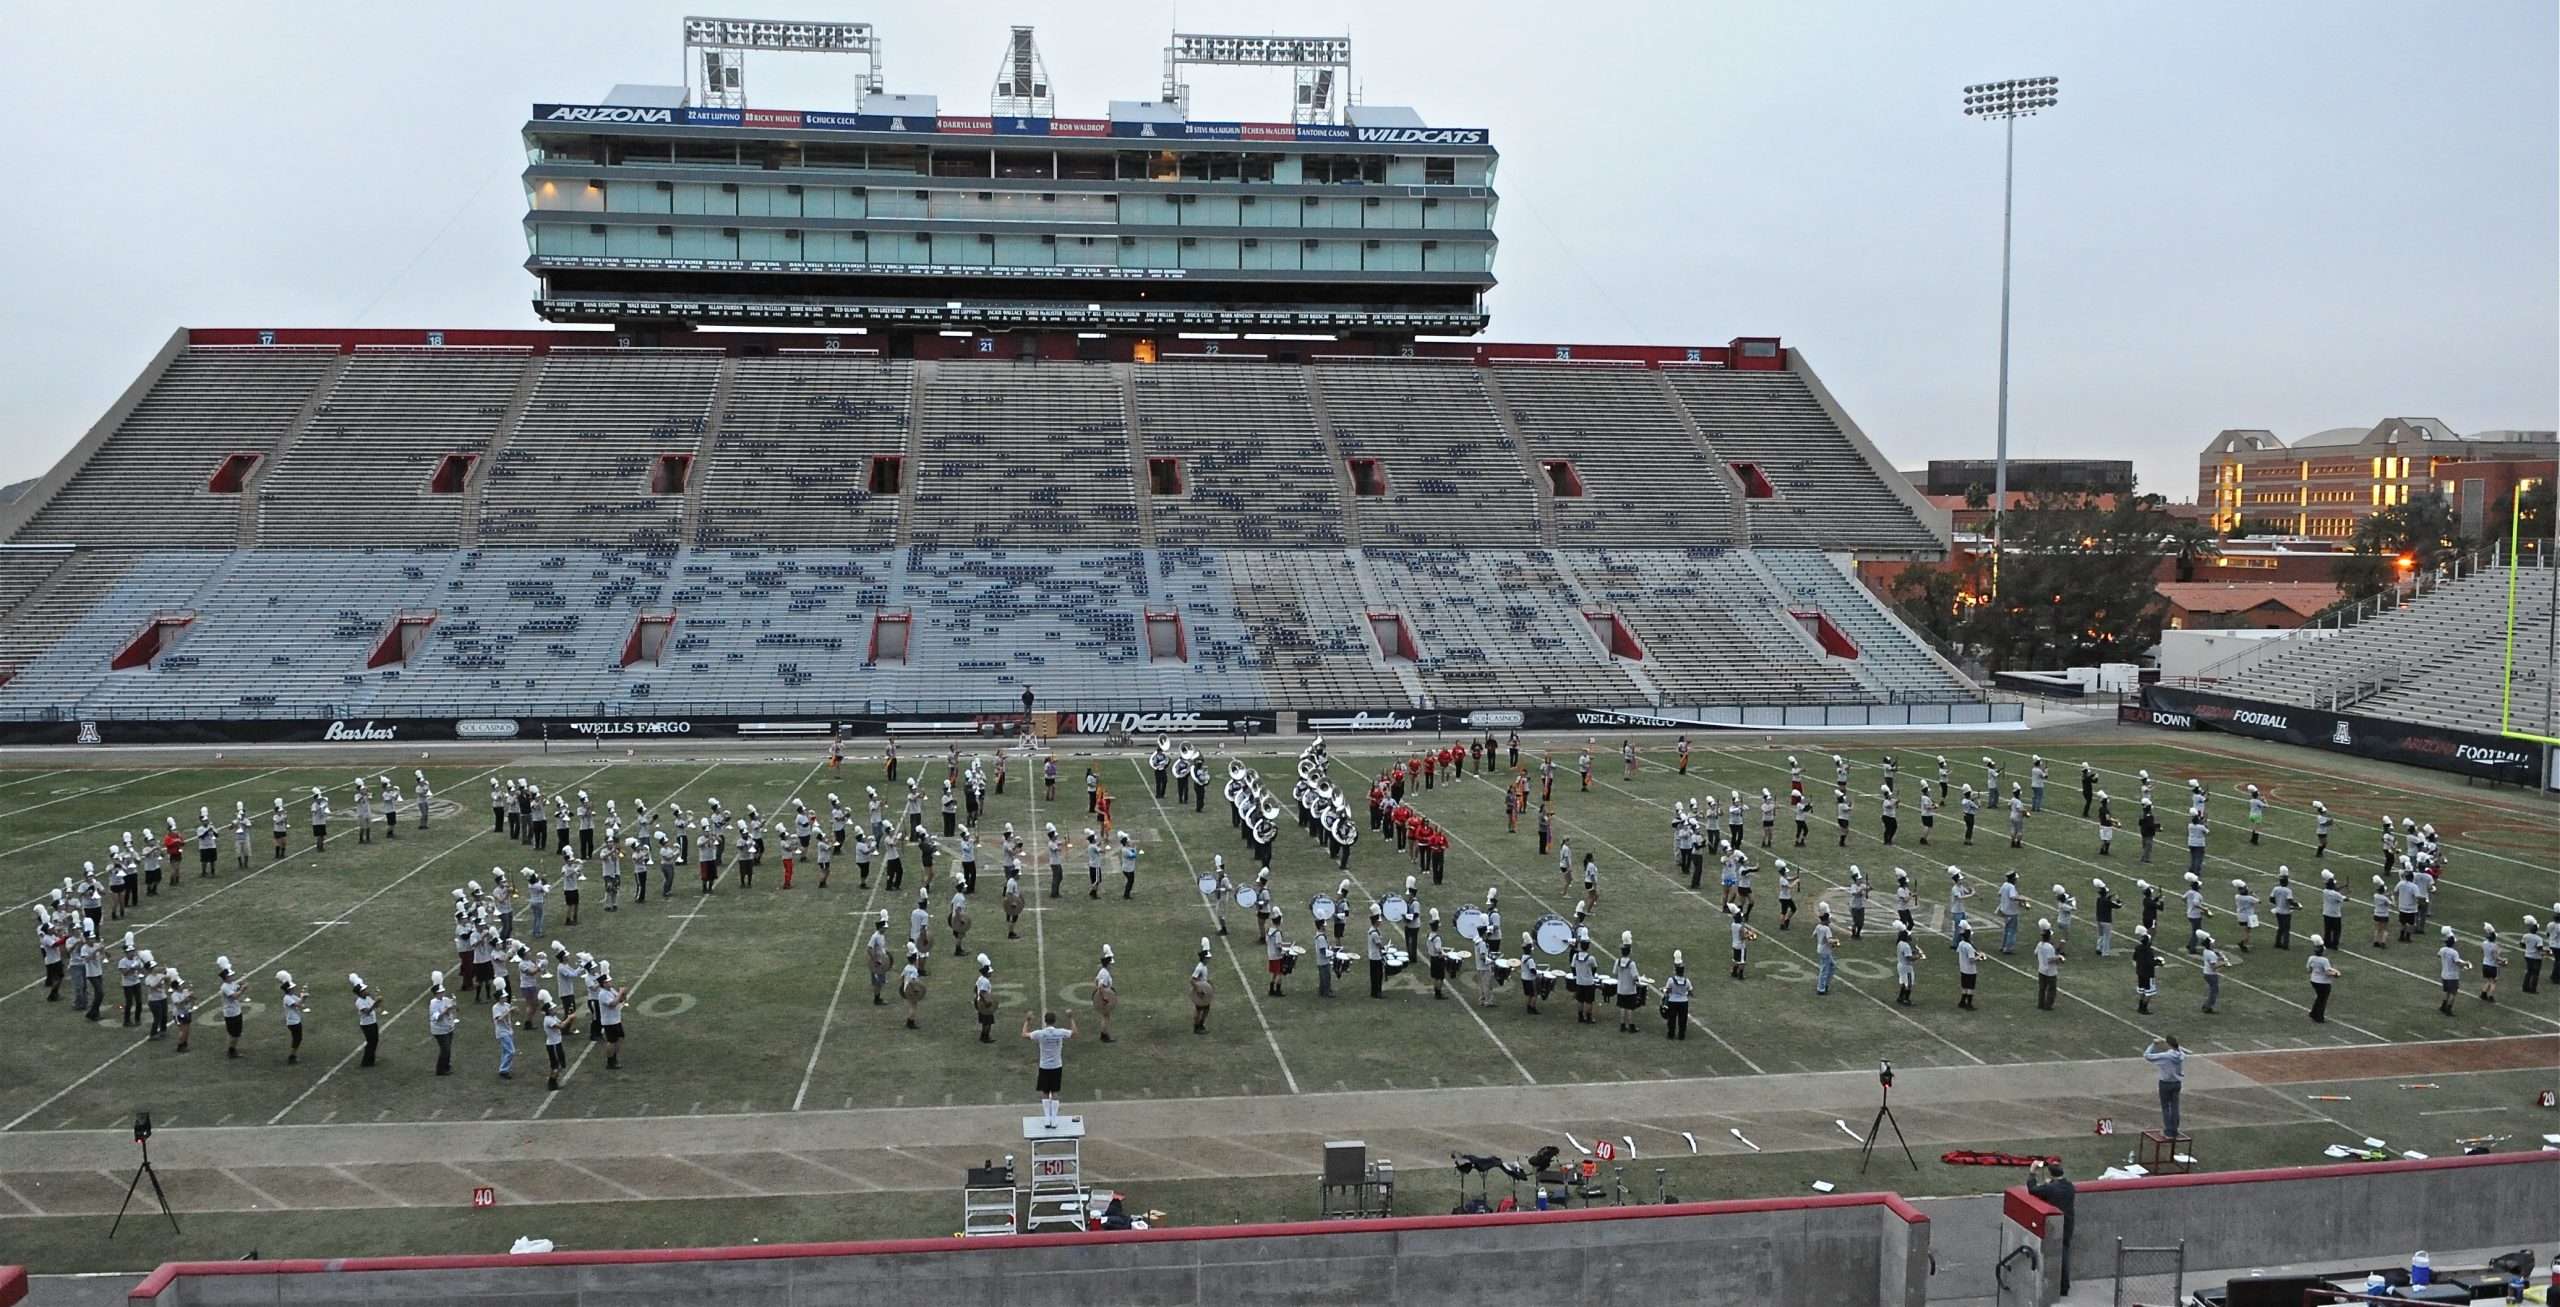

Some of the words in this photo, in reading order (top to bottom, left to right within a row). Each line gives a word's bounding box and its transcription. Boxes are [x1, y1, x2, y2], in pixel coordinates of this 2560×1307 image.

[547, 108, 672, 122] ARIZONA
[688, 111, 696, 119] 22
[775, 115, 801, 123] HUNLEY
[837, 117, 856, 125] CECIL
[938, 120, 942, 128] 4
[1241, 126, 1247, 134] 11
[1358, 129, 1482, 143] WILDCATS
[261, 336, 272, 345] 17
[429, 336, 441, 345] 18
[618, 338, 630, 347] 19
[826, 340, 840, 349] 20
[981, 342, 992, 351] 21
[1206, 346, 1219, 355] 22
[1401, 348, 1414, 357] 23
[1557, 351, 1569, 360] 24
[1688, 353, 1700, 362] 25
[1077, 712, 1200, 733] WILDCATS
[1577, 714, 1625, 725] WELLS
[2153, 712, 2190, 727] DOWN
[2233, 709, 2287, 729] FOOTBALL
[324, 721, 397, 741] Bashas'
[476, 724, 513, 732] CASINOS
[579, 723, 633, 734] WELLS
[637, 722, 690, 733] FARGO
[2402, 736, 2457, 755] ARIZONA
[2543, 1092, 2554, 1106] 20
[2099, 1119, 2112, 1135] 30
[1597, 1142, 1611, 1159] 40
[1047, 1160, 1062, 1175] 50
[475, 1190, 492, 1206] 40
